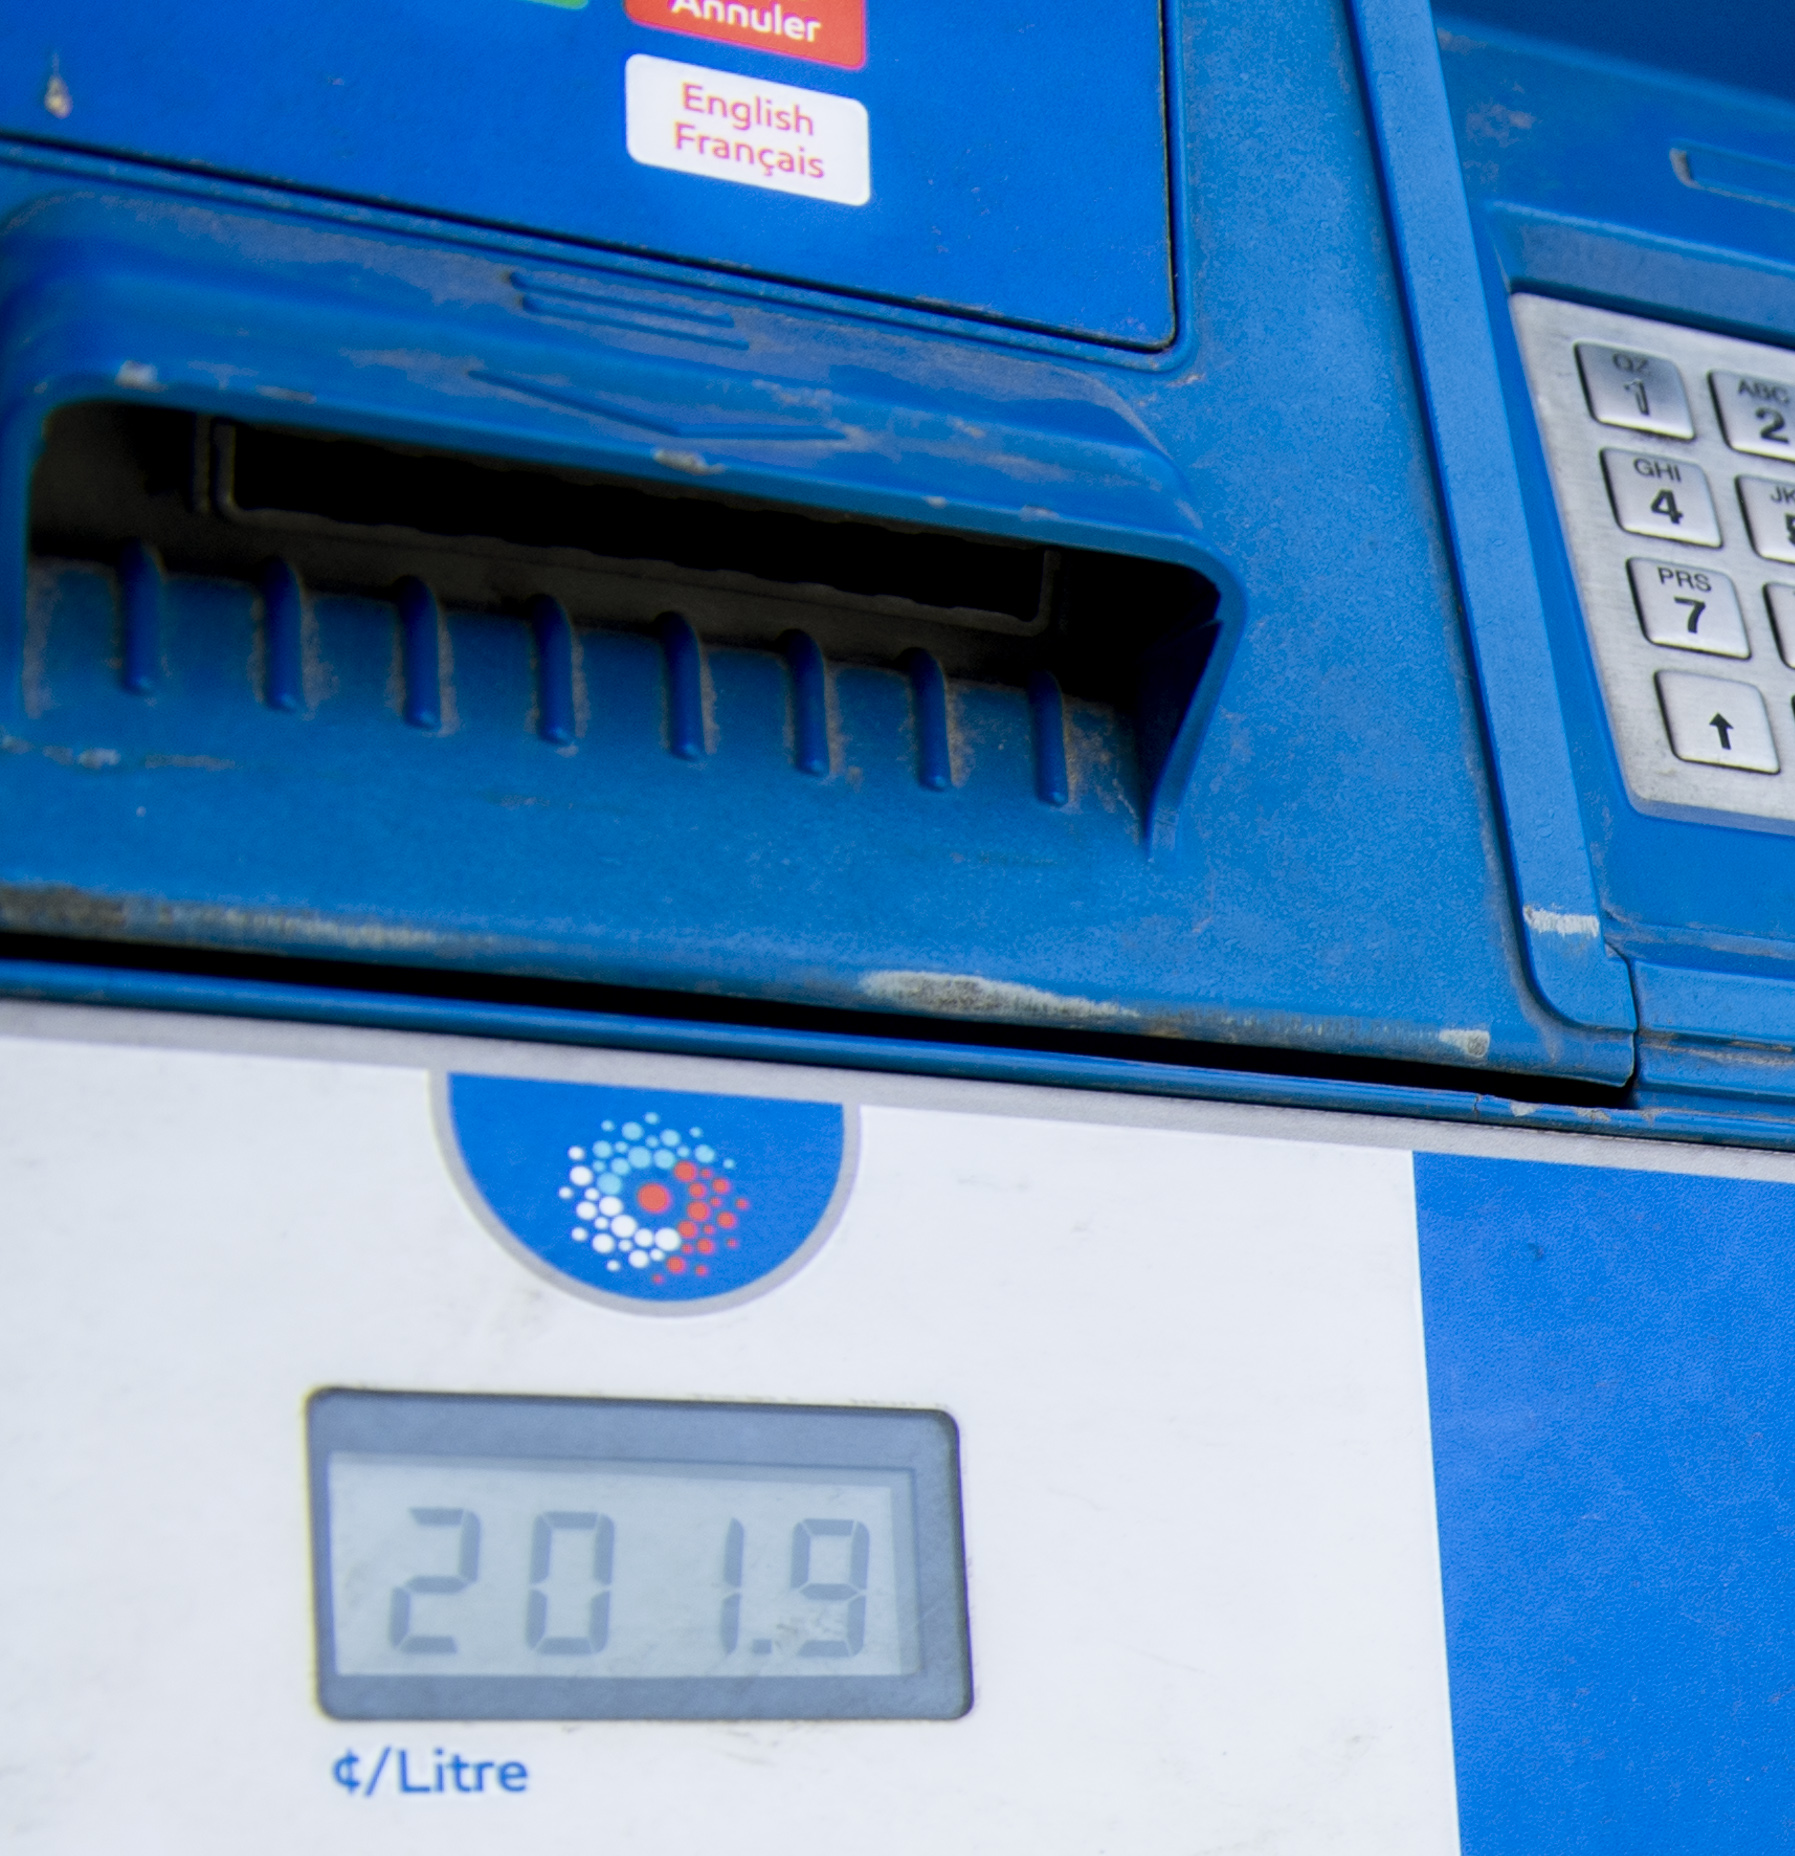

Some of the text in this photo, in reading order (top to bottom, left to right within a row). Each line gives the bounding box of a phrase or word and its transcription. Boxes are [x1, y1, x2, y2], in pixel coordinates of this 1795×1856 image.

[681, 82, 815, 137] English
[674, 121, 825, 179] Français
[1612, 353, 1649, 374] QZ
[1624, 378, 1650, 416] 1
[1737, 379, 1790, 405] ABC
[1755, 407, 1789, 444] 2
[1633, 458, 1682, 483] GHI
[1650, 489, 1683, 525] 4
[1657, 567, 1712, 592] PRS
[1674, 596, 1706, 634] 7
[387, 1507, 871, 1659] 201.9
[332, 1745, 529, 1797] ¢/Litre
